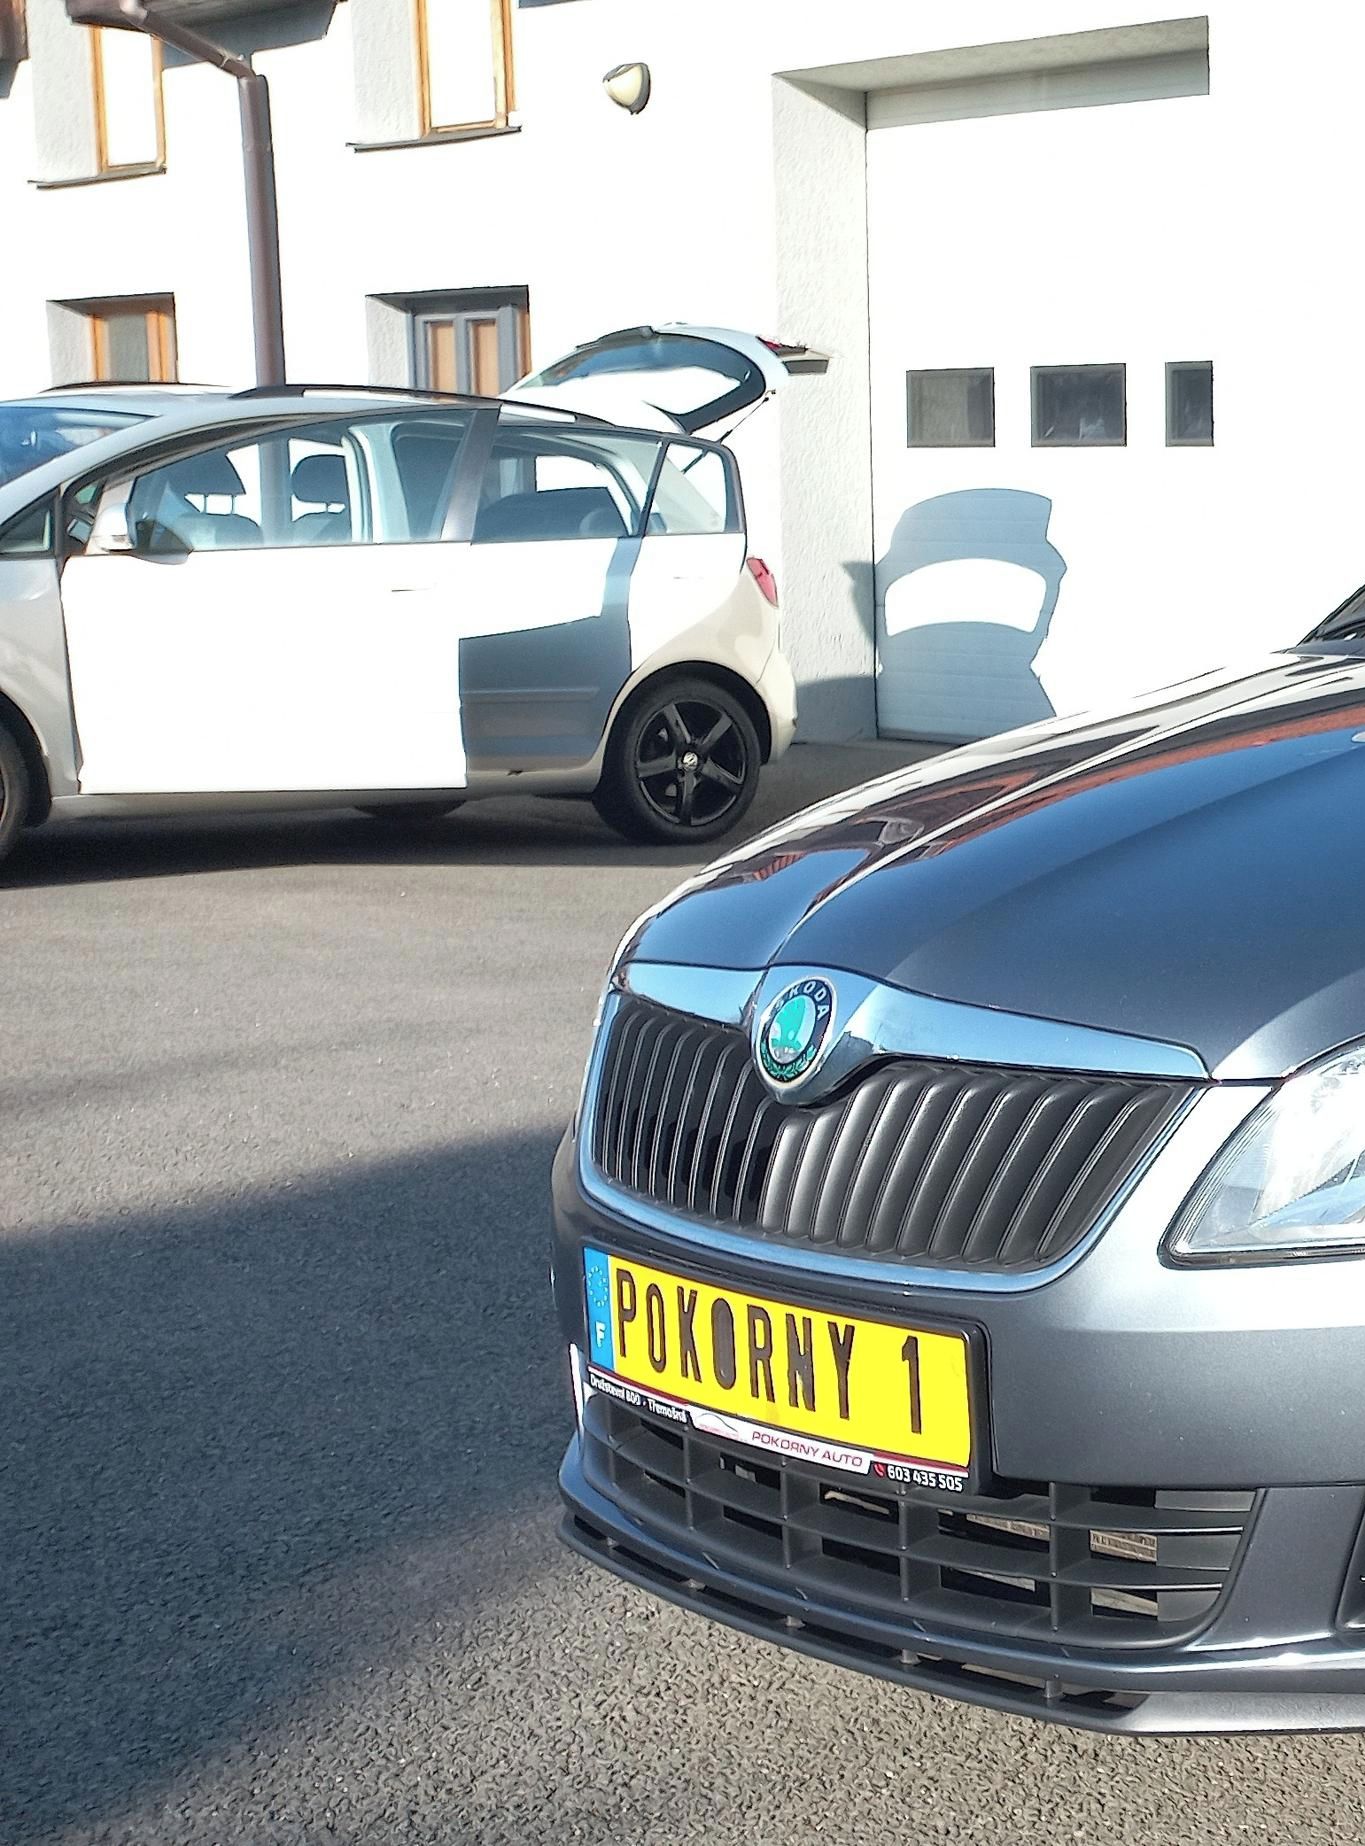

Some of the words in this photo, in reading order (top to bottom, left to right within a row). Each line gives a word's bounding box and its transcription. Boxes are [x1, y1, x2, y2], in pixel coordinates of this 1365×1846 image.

[596, 1321, 606, 1348] F
[616, 1266, 855, 1420] POKORNY
[901, 1335, 922, 1434] 1
[752, 1430, 820, 1457] POKORNY
[821, 1451, 863, 1468] AUTO
[887, 1465, 911, 1483] 603
[913, 1470, 936, 1488] 435
[939, 1474, 963, 1492] 505
